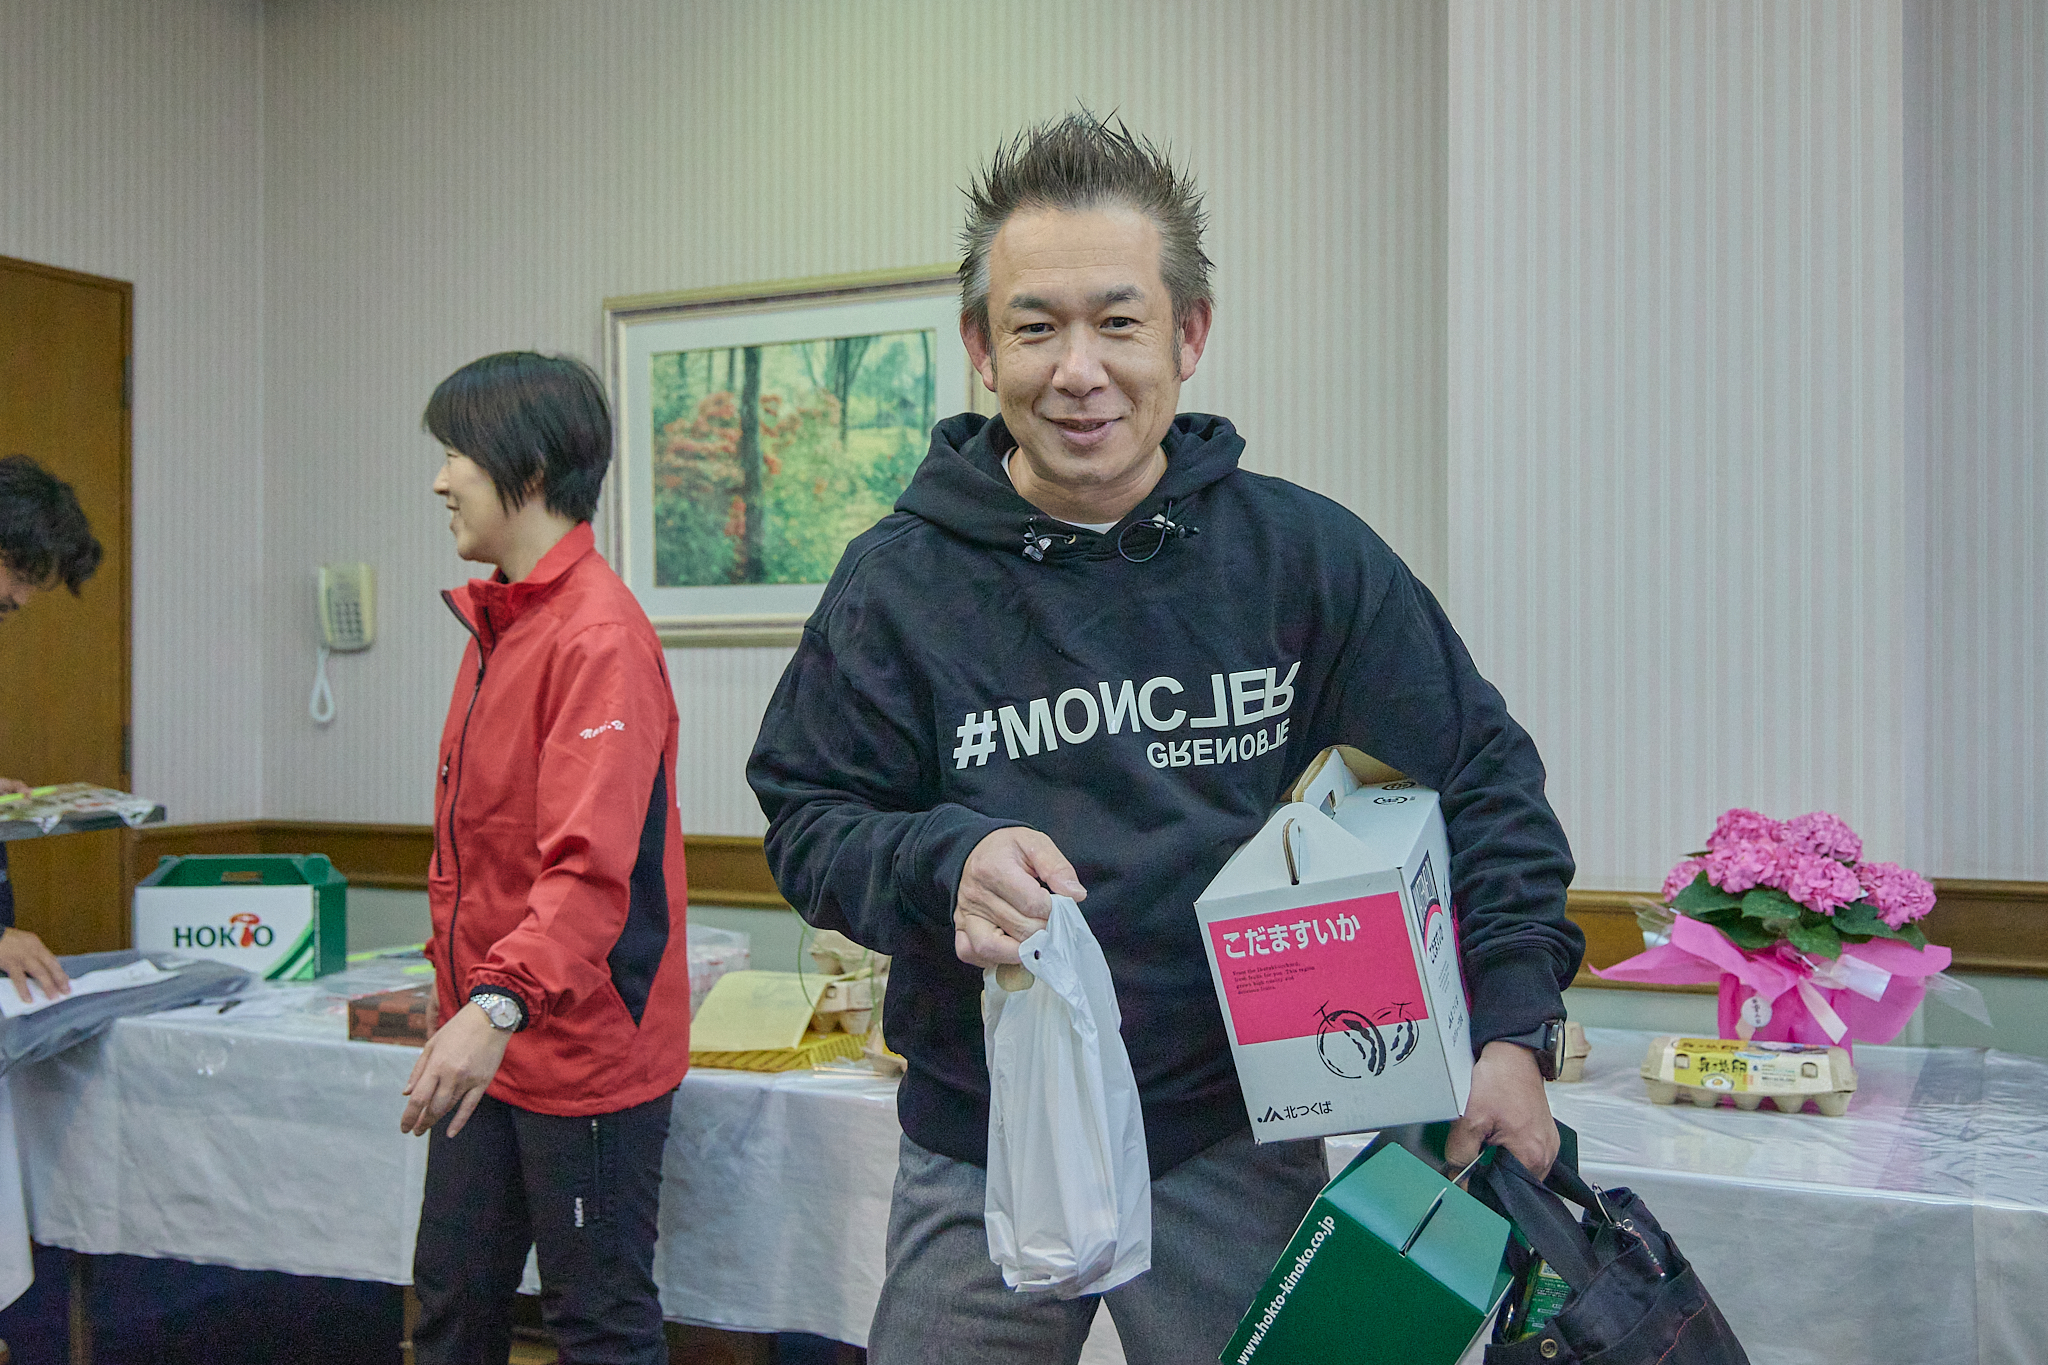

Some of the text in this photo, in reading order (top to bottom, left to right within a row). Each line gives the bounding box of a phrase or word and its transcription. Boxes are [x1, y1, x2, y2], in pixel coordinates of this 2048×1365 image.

[1146, 717, 1291, 769] GRENOBLE
[174, 913, 275, 948] HOKTO
[1222, 913, 1361, 958] こだますいか
[1283, 1100, 1333, 1119] 北つくば
[1237, 1215, 1335, 1365] www.hokto-kinoko.co.jp
